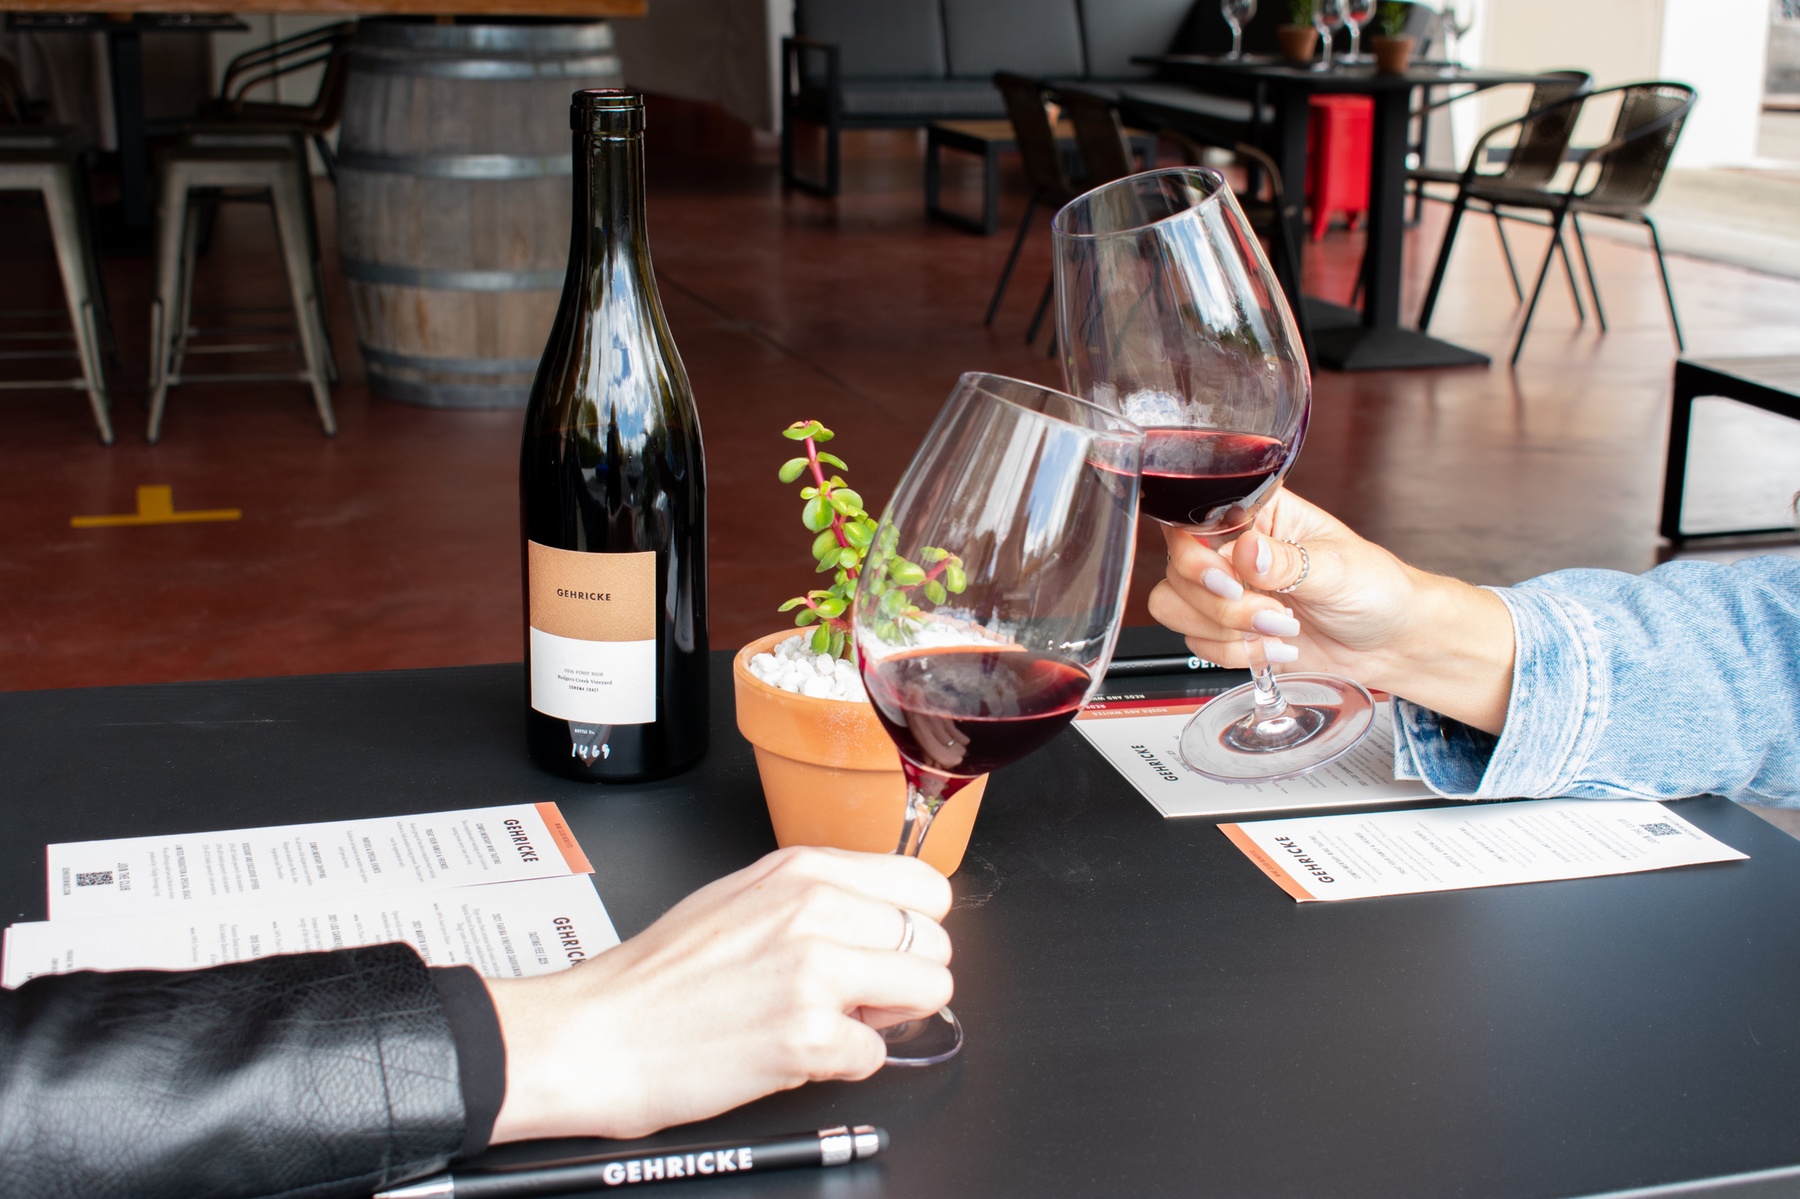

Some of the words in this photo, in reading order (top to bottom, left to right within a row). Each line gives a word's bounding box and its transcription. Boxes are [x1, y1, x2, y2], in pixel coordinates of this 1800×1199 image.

[556, 588, 611, 601] GEHRICKE
[1130, 744, 1178, 781] GEHRICKE
[502, 818, 539, 862] GEHRICKE
[117, 862, 128, 871] JOIN
[1275, 836, 1335, 883] GEHRICKE
[119, 880, 130, 890] CLUB
[528, 932, 538, 946] TASTING
[552, 916, 586, 967] GEHRICK
[602, 1147, 753, 1185] GEHRICKE
